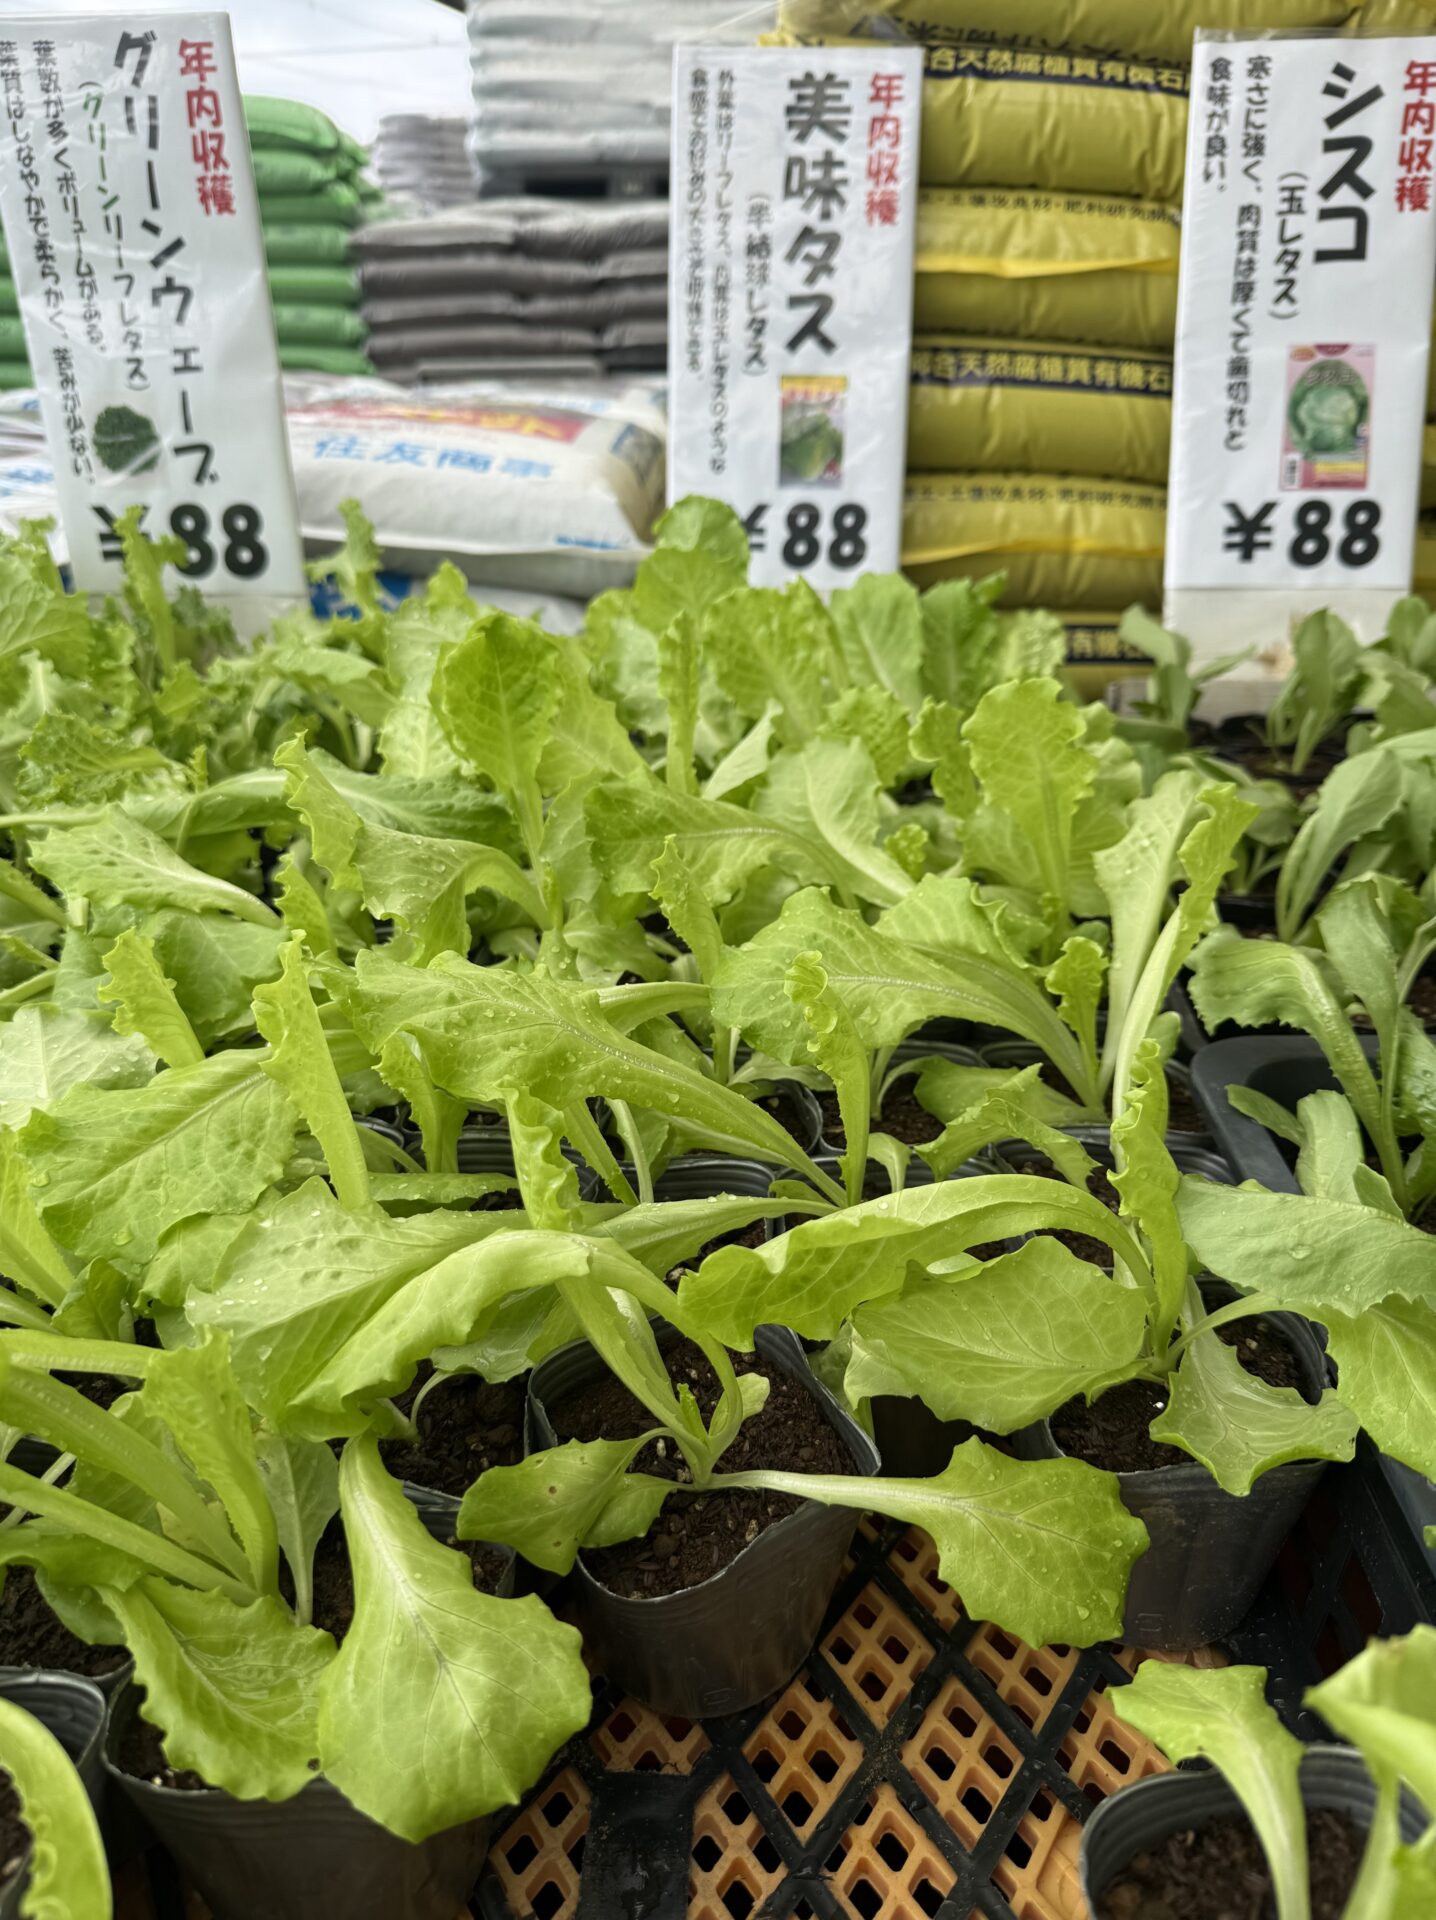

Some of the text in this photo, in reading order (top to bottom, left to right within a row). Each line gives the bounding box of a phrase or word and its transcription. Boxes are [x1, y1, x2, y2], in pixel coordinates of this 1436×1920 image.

[178, 38, 237, 218] 年内収穫
[784, 70, 853, 355] 美味タス
[865, 71, 906, 226] 年内収穫
[1313, 62, 1386, 265] シスコ
[1395, 59, 1436, 213] 年内収穫
